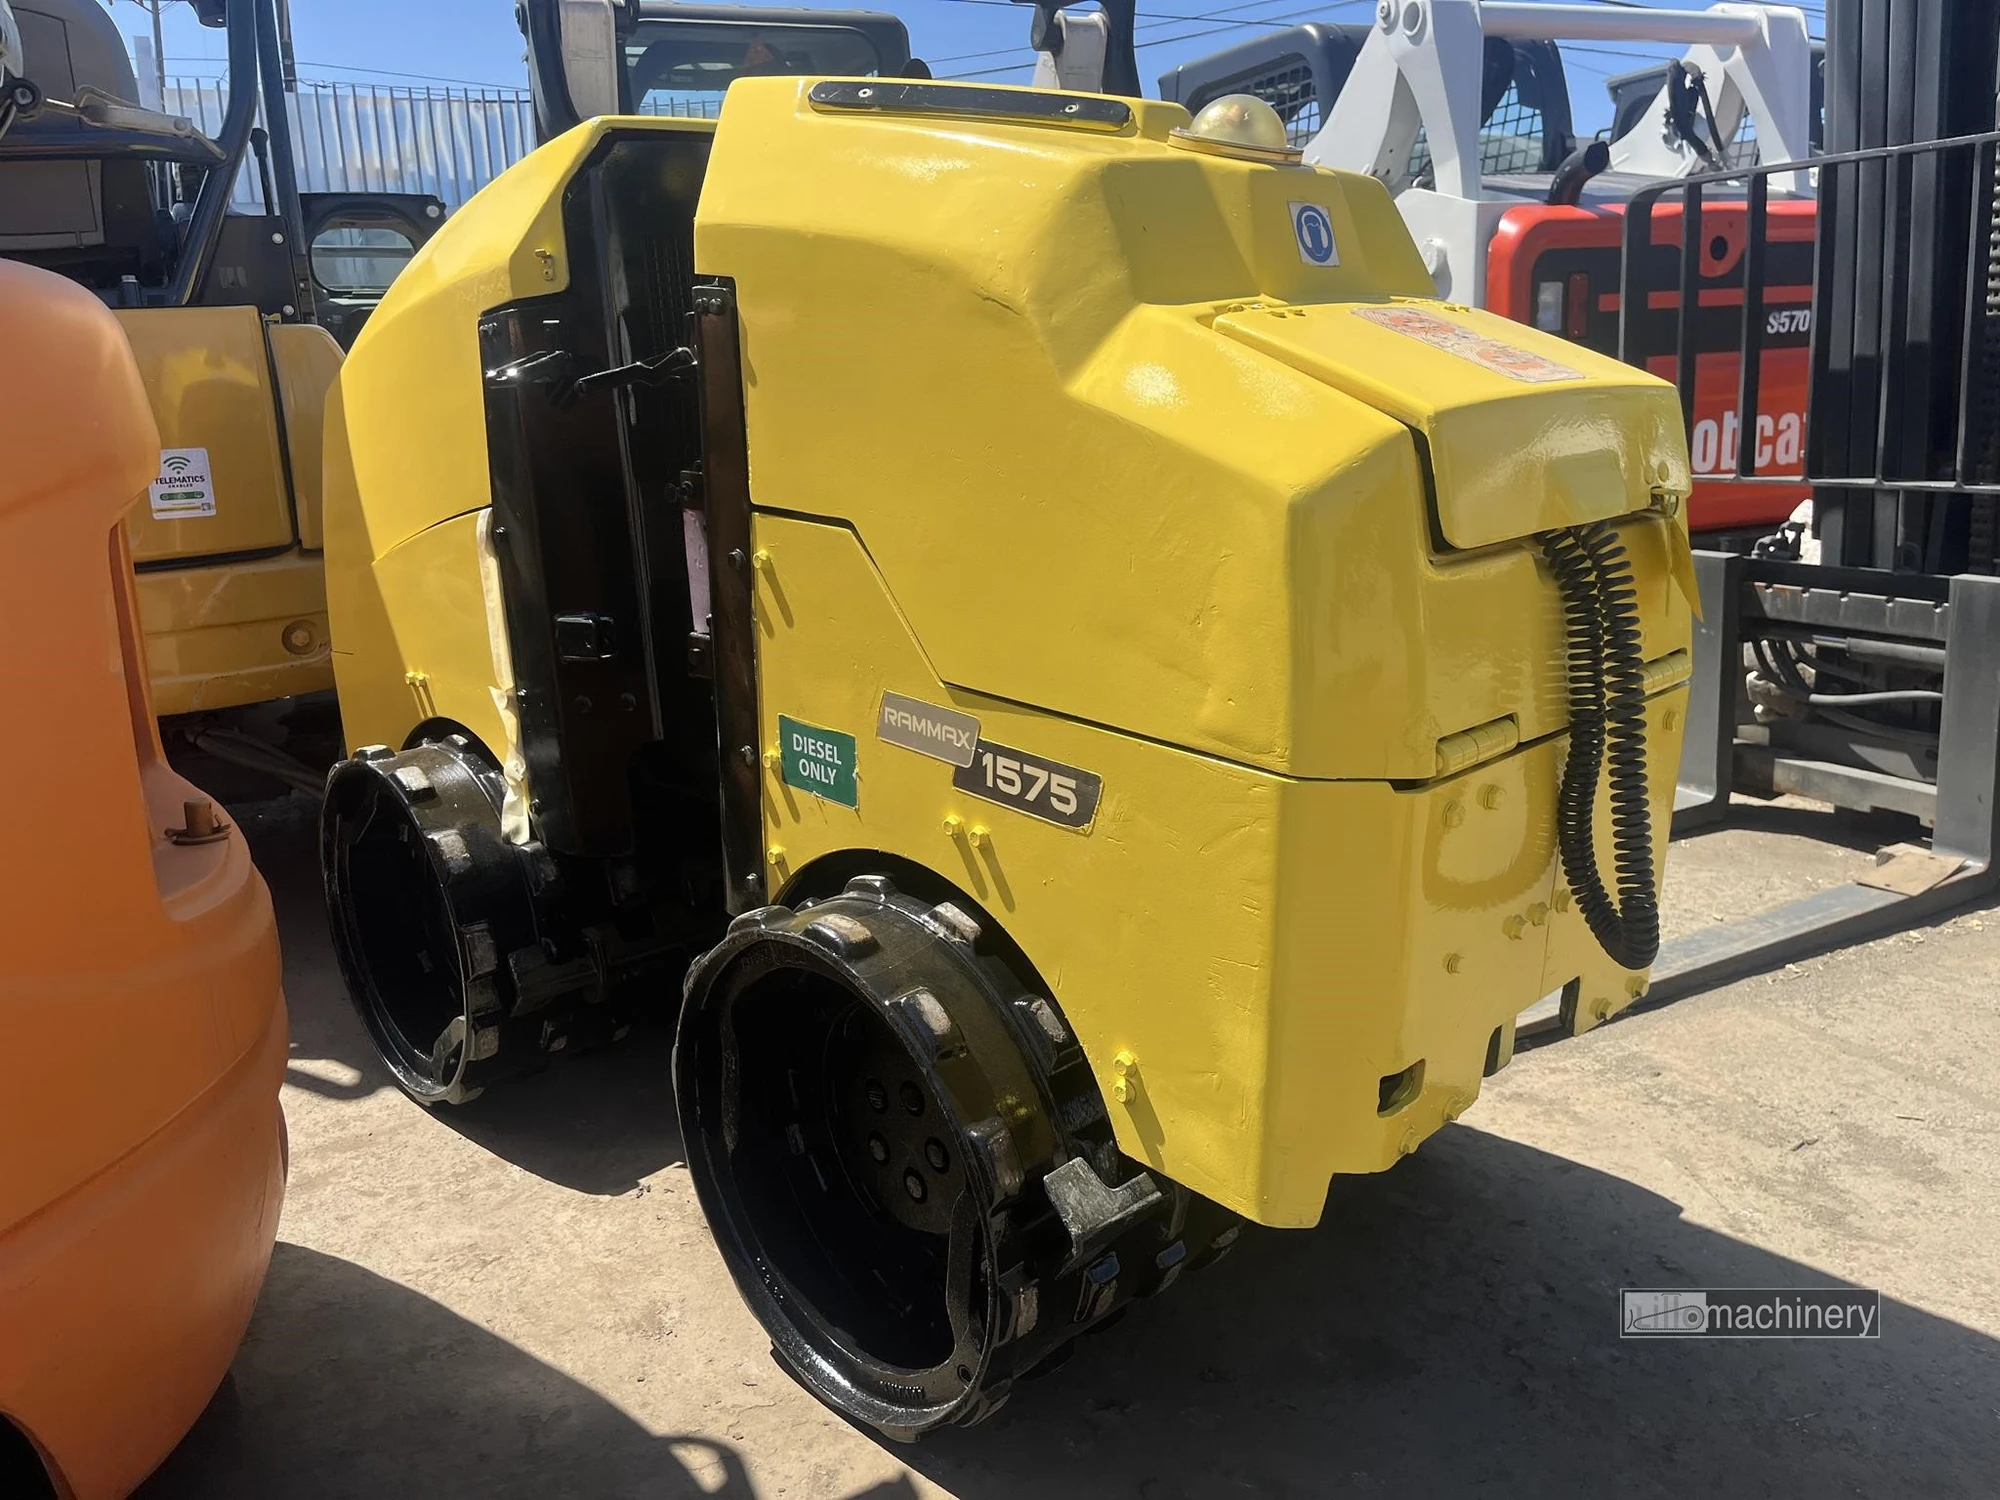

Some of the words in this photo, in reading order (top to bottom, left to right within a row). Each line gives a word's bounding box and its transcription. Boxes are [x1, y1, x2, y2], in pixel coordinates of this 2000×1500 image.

[1766, 309, 1811, 334] S570
[884, 706, 972, 750] RAMMAX
[792, 733, 842, 765] DIESEL
[799, 758, 837, 785] ONLY
[982, 752, 1078, 815] 1575
